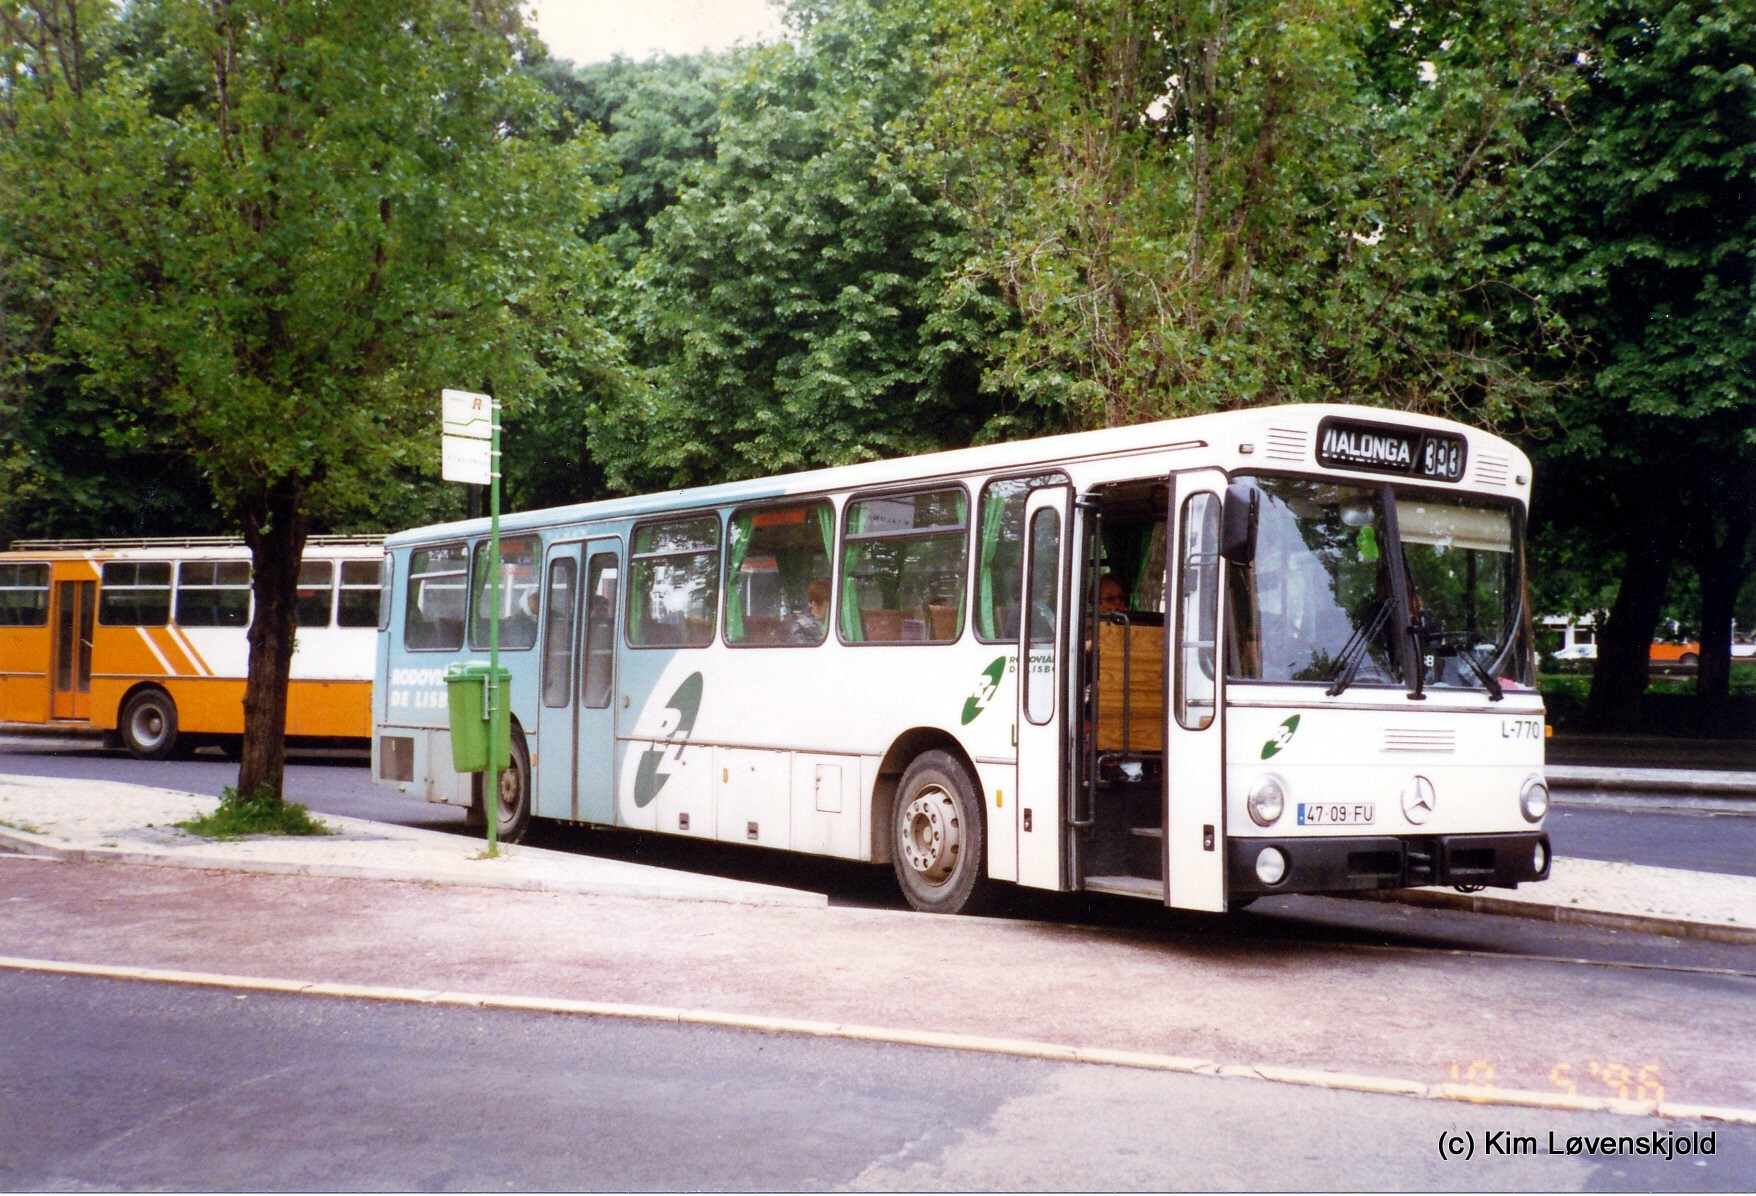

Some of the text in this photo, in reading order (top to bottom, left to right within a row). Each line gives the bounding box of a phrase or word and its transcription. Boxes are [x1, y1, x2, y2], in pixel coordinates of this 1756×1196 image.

[390, 690, 450, 708] DE LISB
[1502, 720, 1540, 739] L-770
